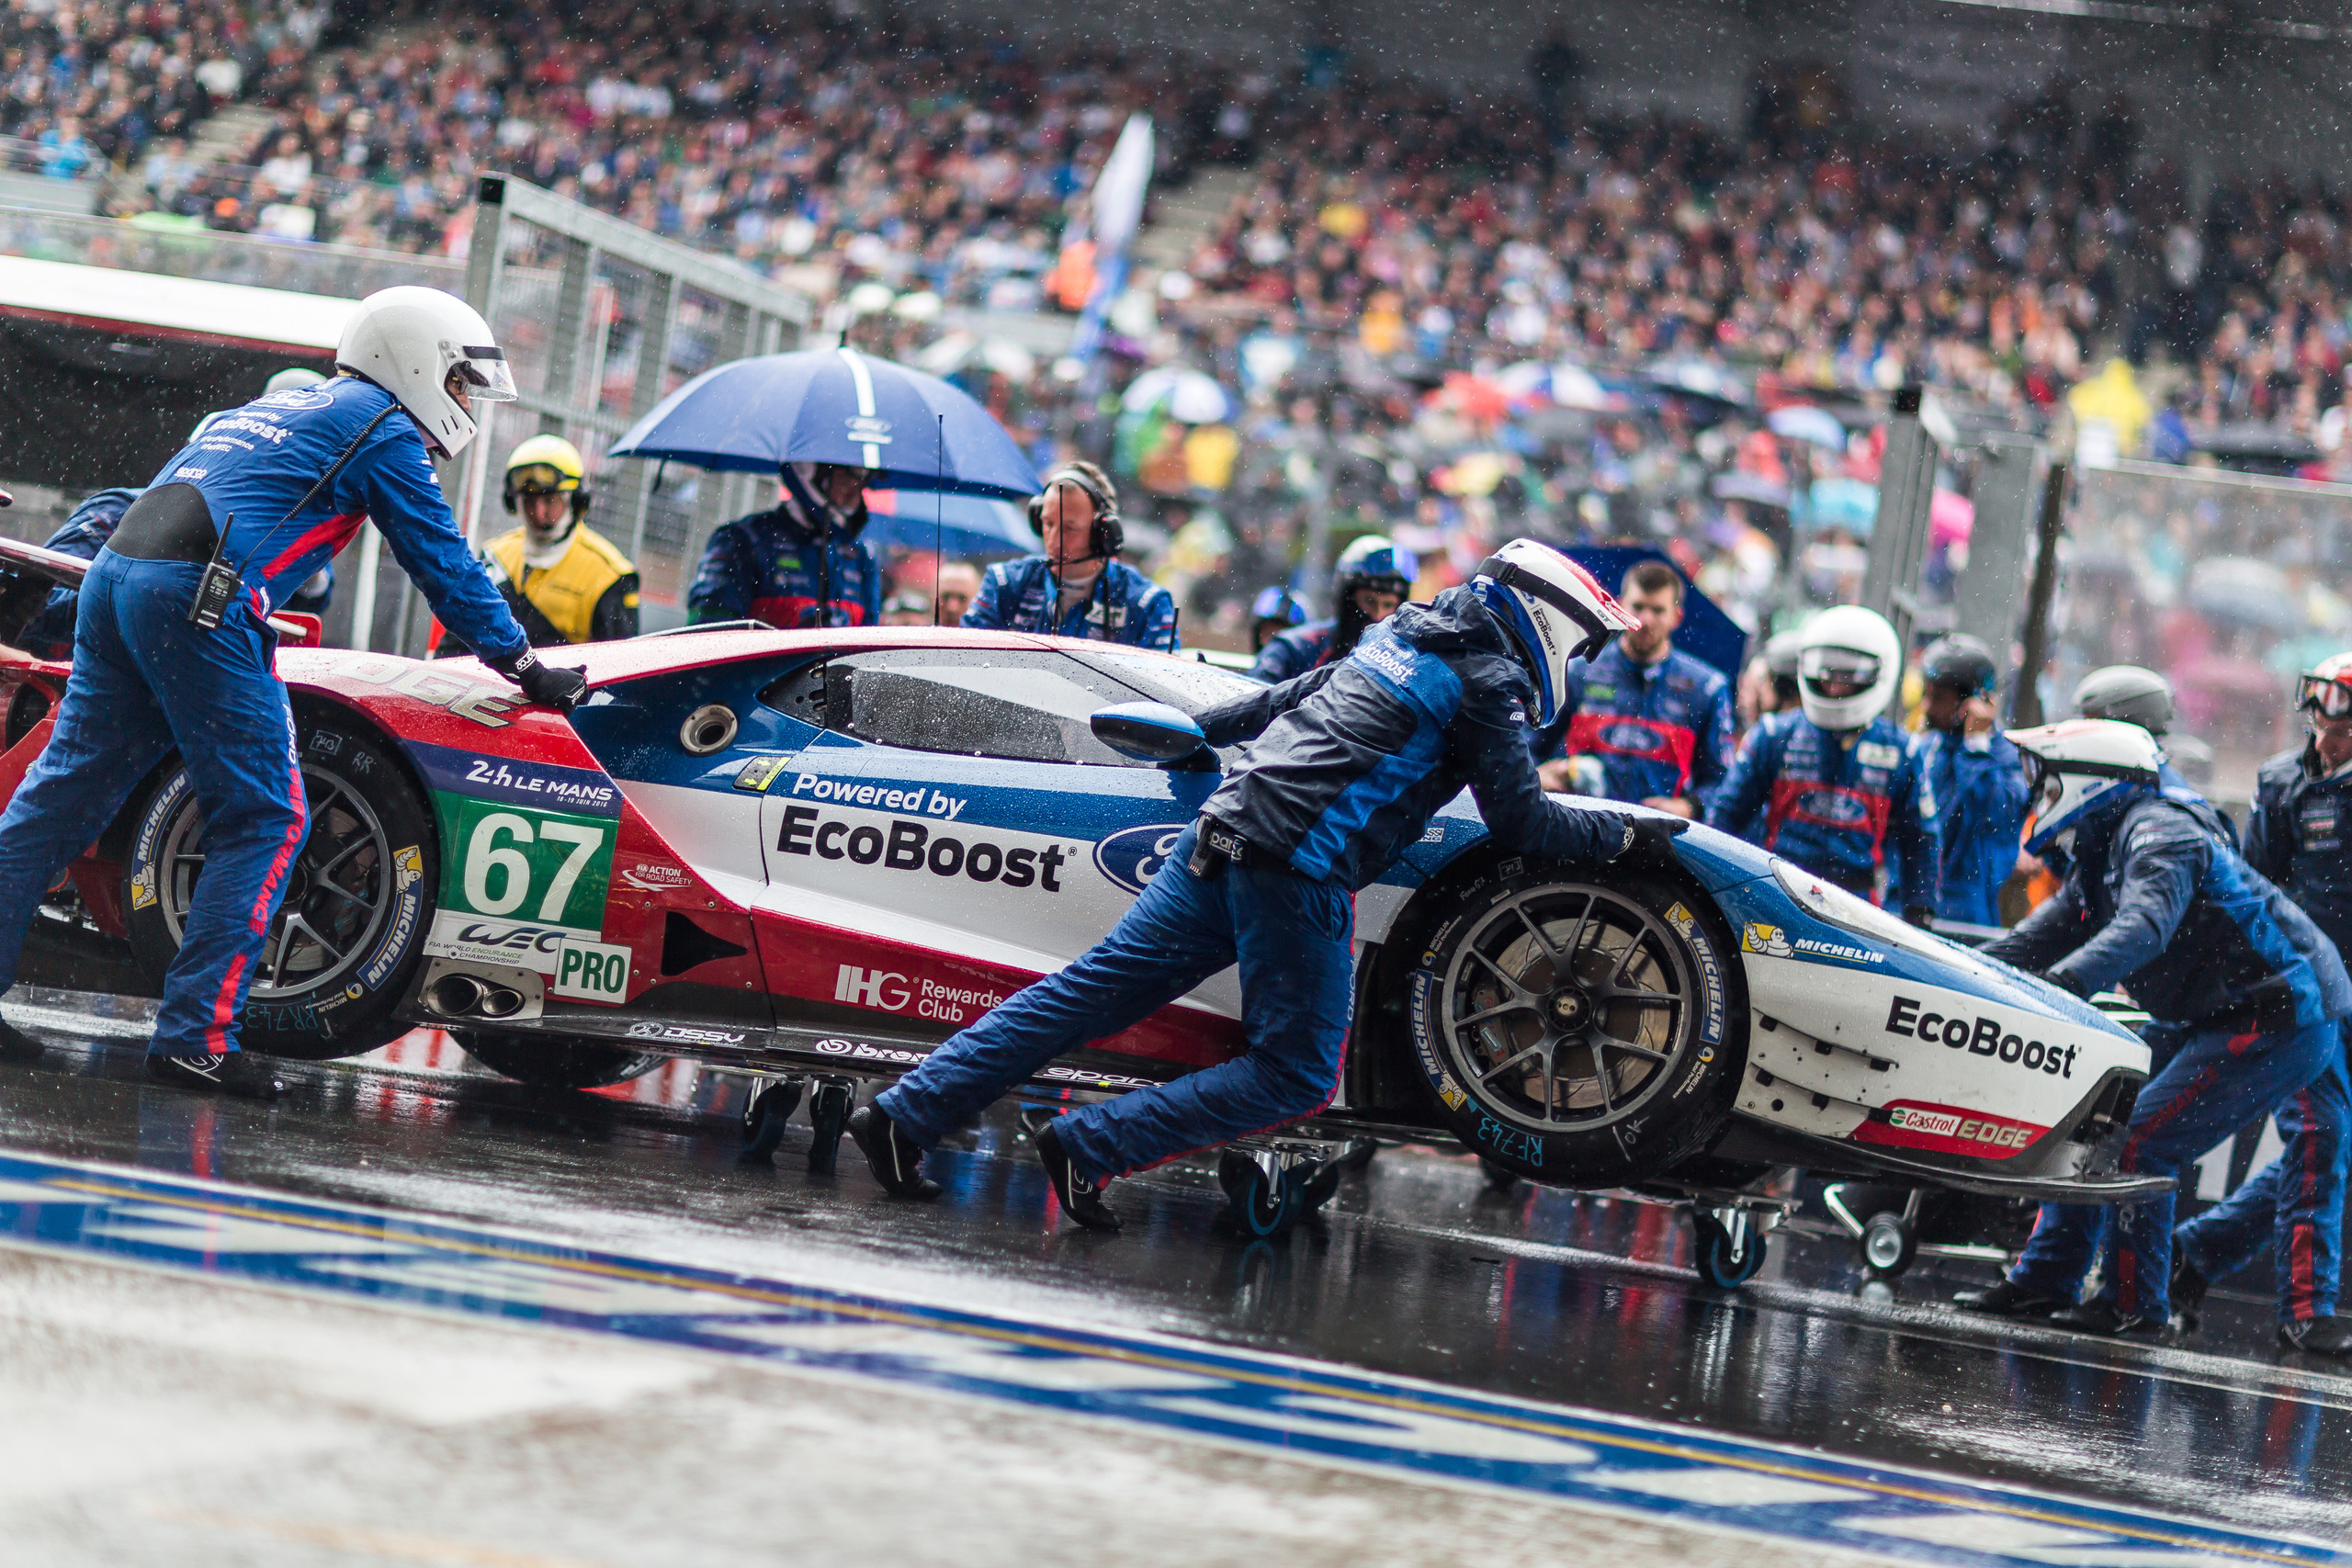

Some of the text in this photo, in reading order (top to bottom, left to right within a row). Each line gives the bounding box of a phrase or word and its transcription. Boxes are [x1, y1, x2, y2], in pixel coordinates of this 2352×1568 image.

[266, 412, 282, 423] by
[1532, 609, 1555, 650] EcoBoost
[516, 650, 537, 671] parco
[466, 761, 613, 801] 24h LE MANS
[576, 797, 591, 807] JUIN
[592, 800, 608, 808] 2016
[791, 772, 967, 822] Powered by
[138, 773, 187, 863] MICHELIN
[248, 704, 307, 936] FORD PERFORMANCE
[464, 812, 605, 922] 67
[636, 863, 682, 877] FIA ACTION
[645, 873, 665, 883] ROAD
[665, 875, 693, 886] SAFETY
[368, 893, 415, 985] MICHELIN
[457, 923, 568, 954] WEC
[1429, 920, 1450, 950] MICHELIN
[459, 953, 520, 965] CHAMPIONSHIP
[471, 947, 524, 960] ENDURANCE
[1794, 938, 1885, 964] MICHELIN
[560, 947, 627, 994] PRO
[921, 978, 1003, 1009] Rewards
[1693, 937, 1722, 1040] MICHELIN
[318, 996, 347, 1013] MICHELIN
[918, 998, 964, 1022] Club
[1412, 974, 1441, 1075] MICHELIN
[853, 1043, 932, 1064] brem
[1045, 1066, 1168, 1089] spar
[1685, 1063, 1707, 1095] MICHELIN
[1905, 1111, 2034, 1149] Castrol EDGE
